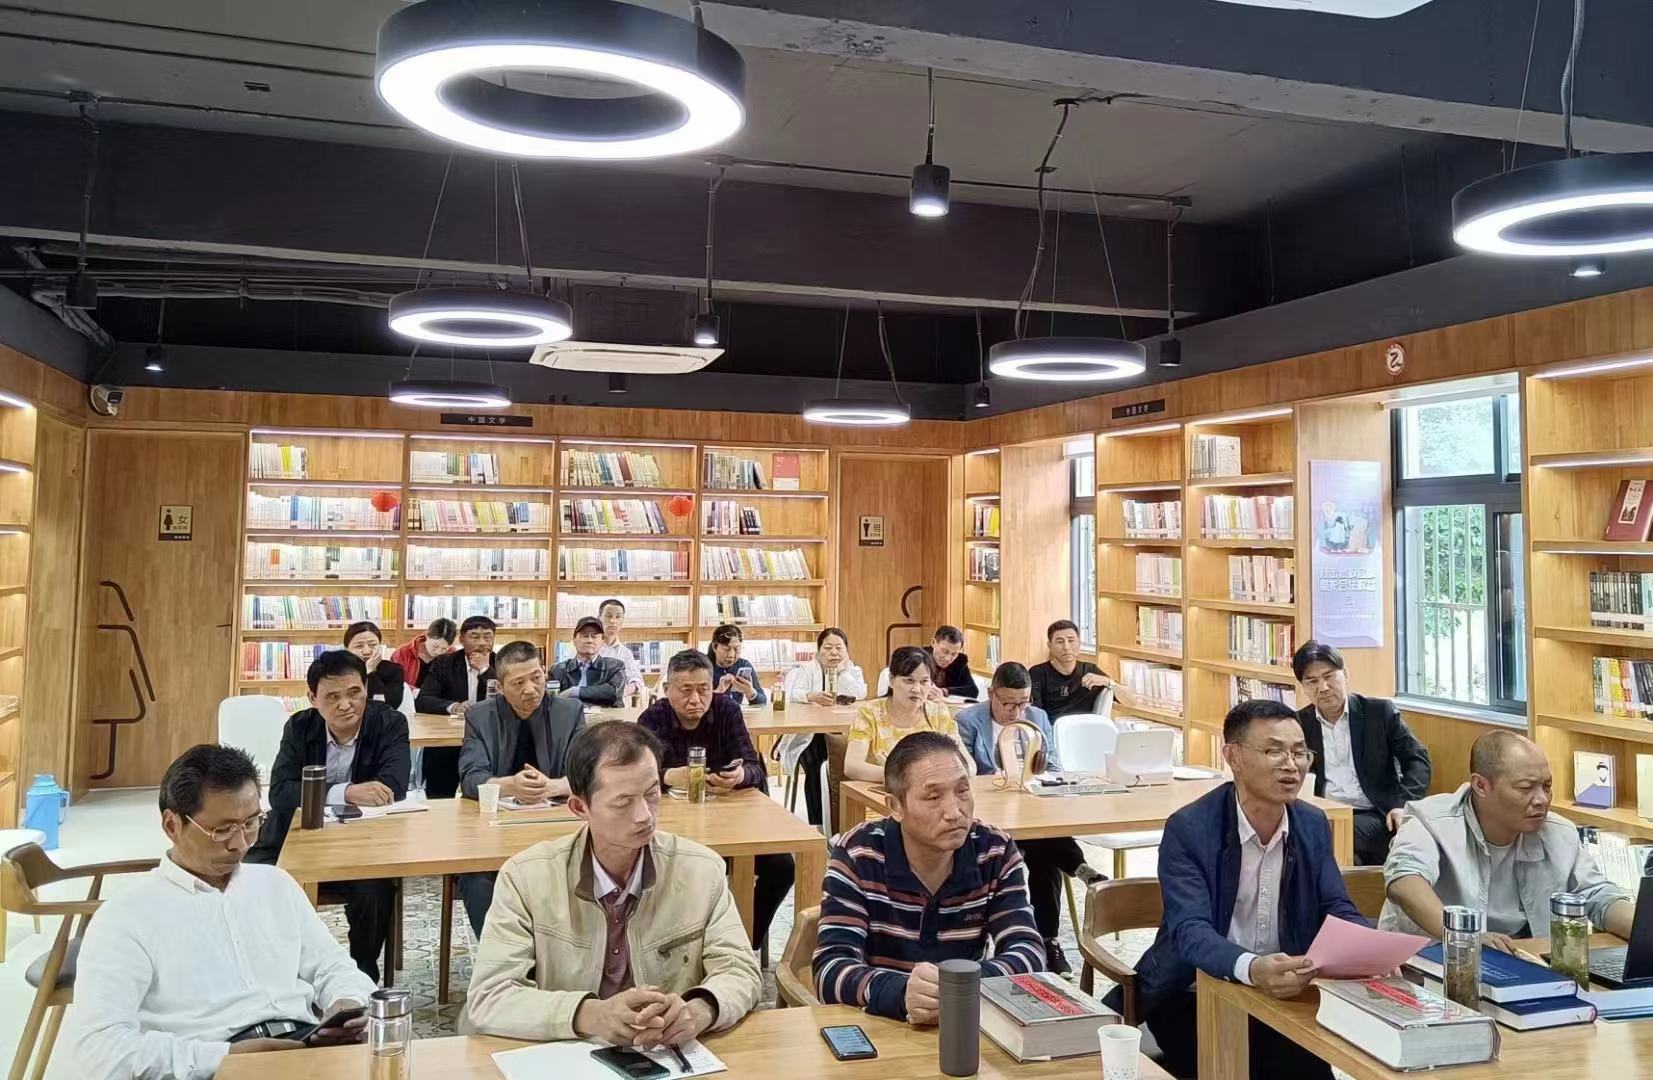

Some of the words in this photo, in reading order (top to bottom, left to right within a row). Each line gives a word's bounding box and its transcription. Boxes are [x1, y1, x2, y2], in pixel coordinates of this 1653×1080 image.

[468, 416, 506, 425] 中国文学
[178, 515, 188, 525] 女
